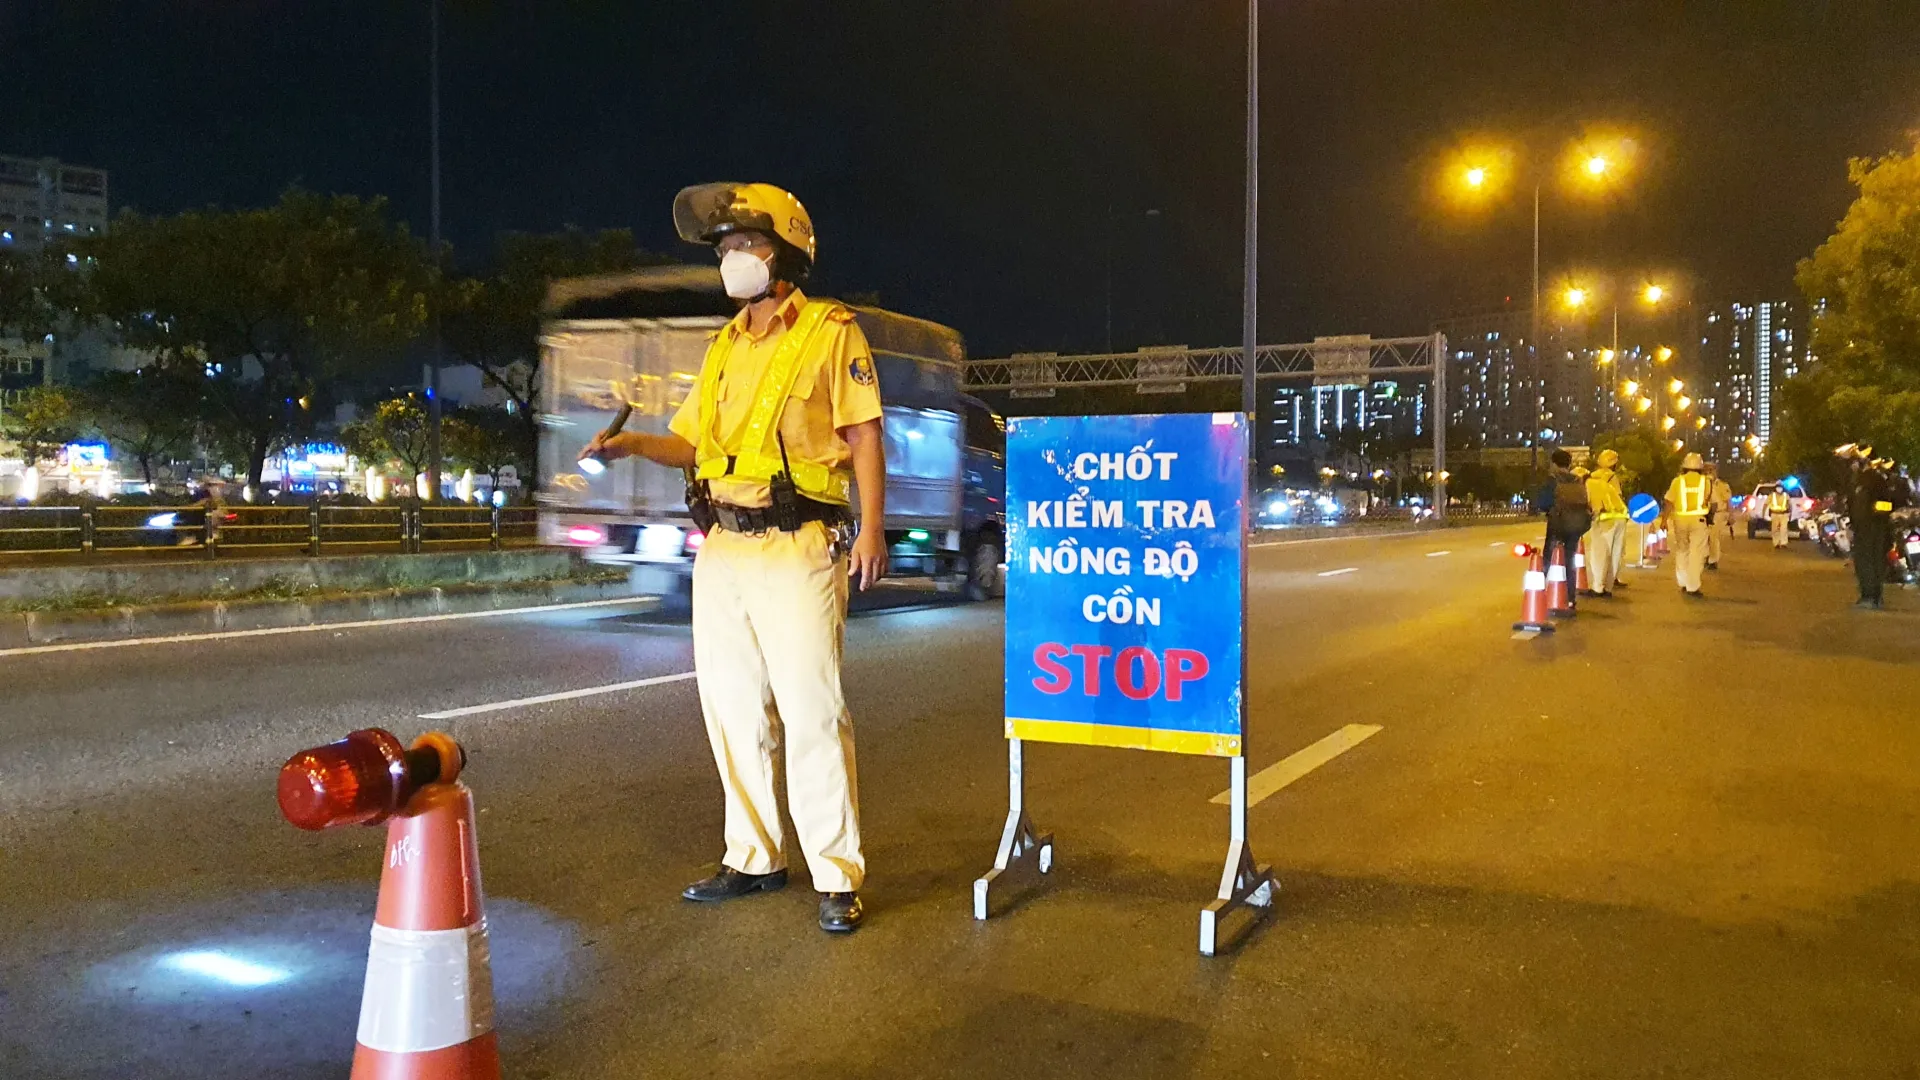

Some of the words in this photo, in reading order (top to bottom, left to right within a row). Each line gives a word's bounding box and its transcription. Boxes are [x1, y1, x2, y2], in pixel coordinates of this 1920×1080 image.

[1074, 439, 1178, 481] CHỐT
[1027, 486, 1124, 528] KIỂM
[1136, 500, 1216, 529] TRA
[1028, 536, 1131, 576] NỒNG
[1143, 541, 1199, 582] ĐỘ
[1082, 584, 1161, 626] CỒN
[1032, 642, 1210, 702] STOP
